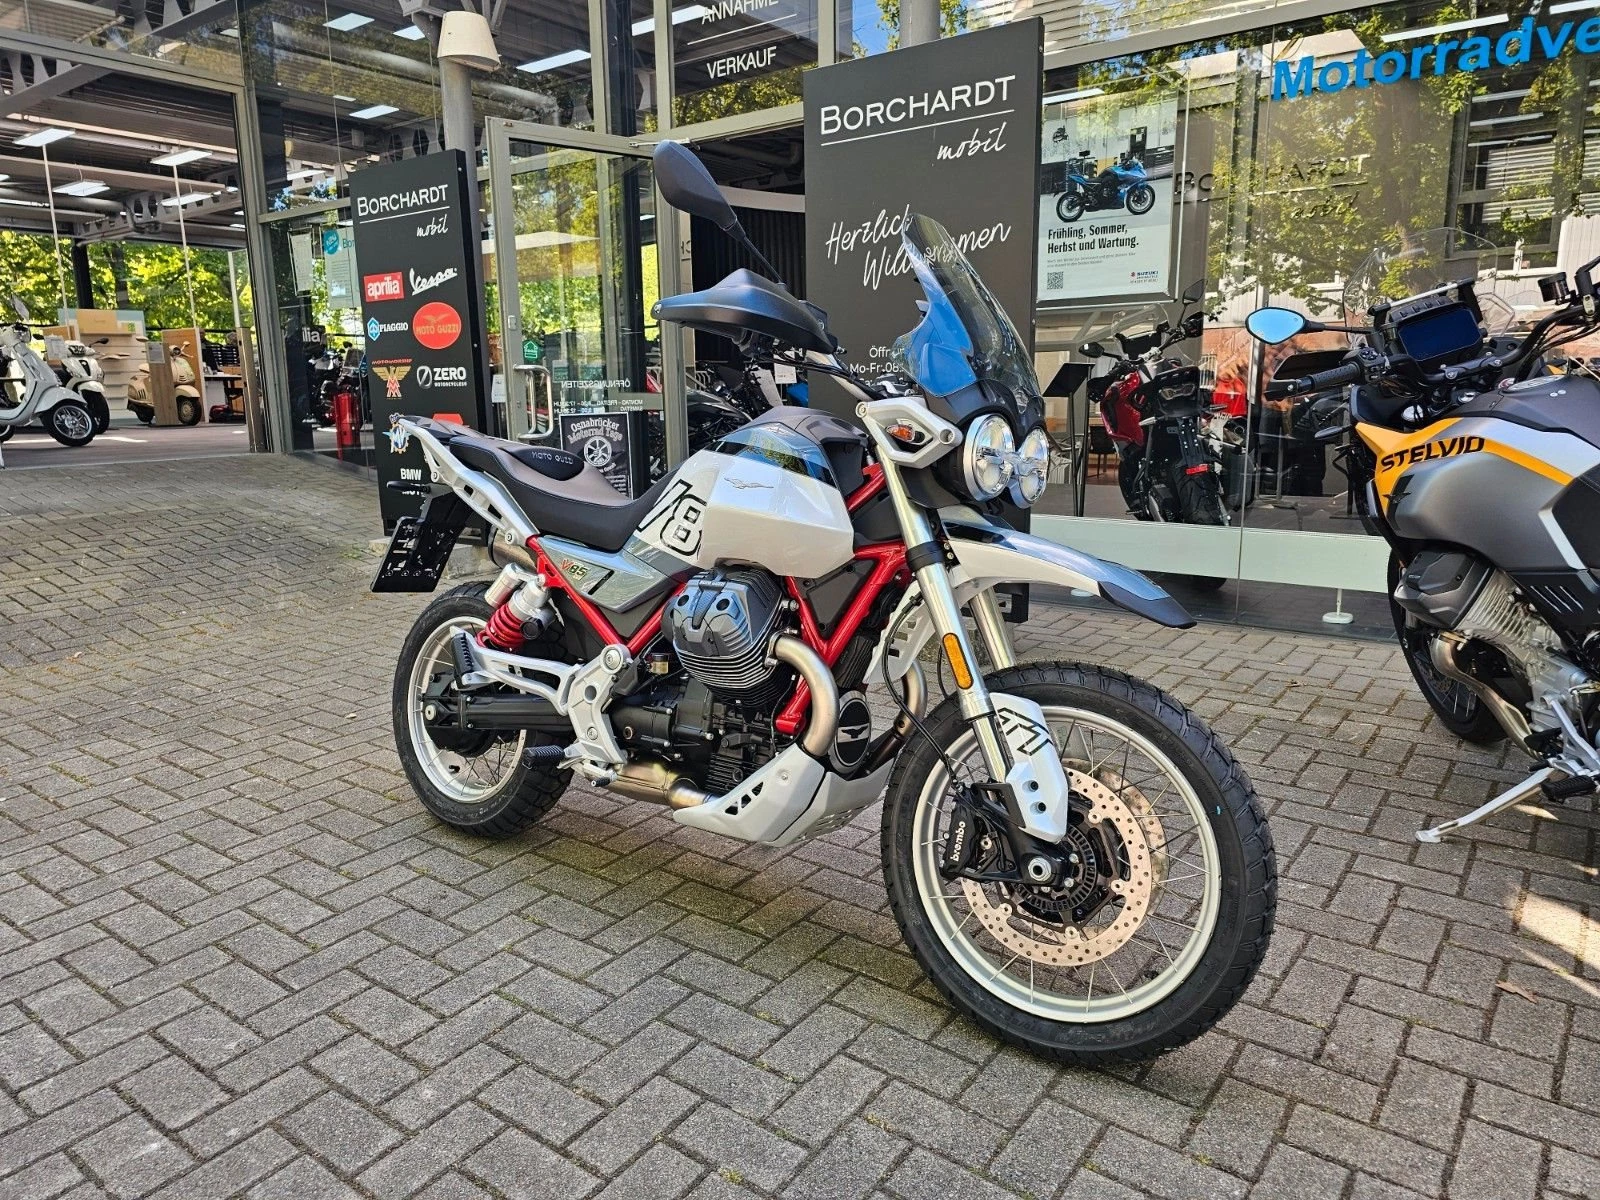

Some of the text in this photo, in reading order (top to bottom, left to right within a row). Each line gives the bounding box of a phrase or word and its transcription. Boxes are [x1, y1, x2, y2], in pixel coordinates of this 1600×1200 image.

[707, 46, 777, 79] VERKAUF
[936, 121, 1007, 160] mobil
[416, 214, 449, 238] mobil
[1047, 223, 1128, 241] Frühling, Sommer,
[1047, 236, 1139, 254] Herbst und Wartung.
[367, 276, 400, 299] aprilia
[409, 267, 458, 296] Vespa
[379, 321, 409, 333] PIAGGIO
[415, 323, 459, 335] MOTO GUZZI
[433, 366, 467, 381] ZERO
[570, 417, 620, 433] Osnabrücker
[532, 451, 552, 461] MOTO
[1381, 436, 1485, 473] STELVIO
[400, 467, 422, 481] BMW
[560, 558, 589, 577] V85
[949, 820, 967, 862] brembo
